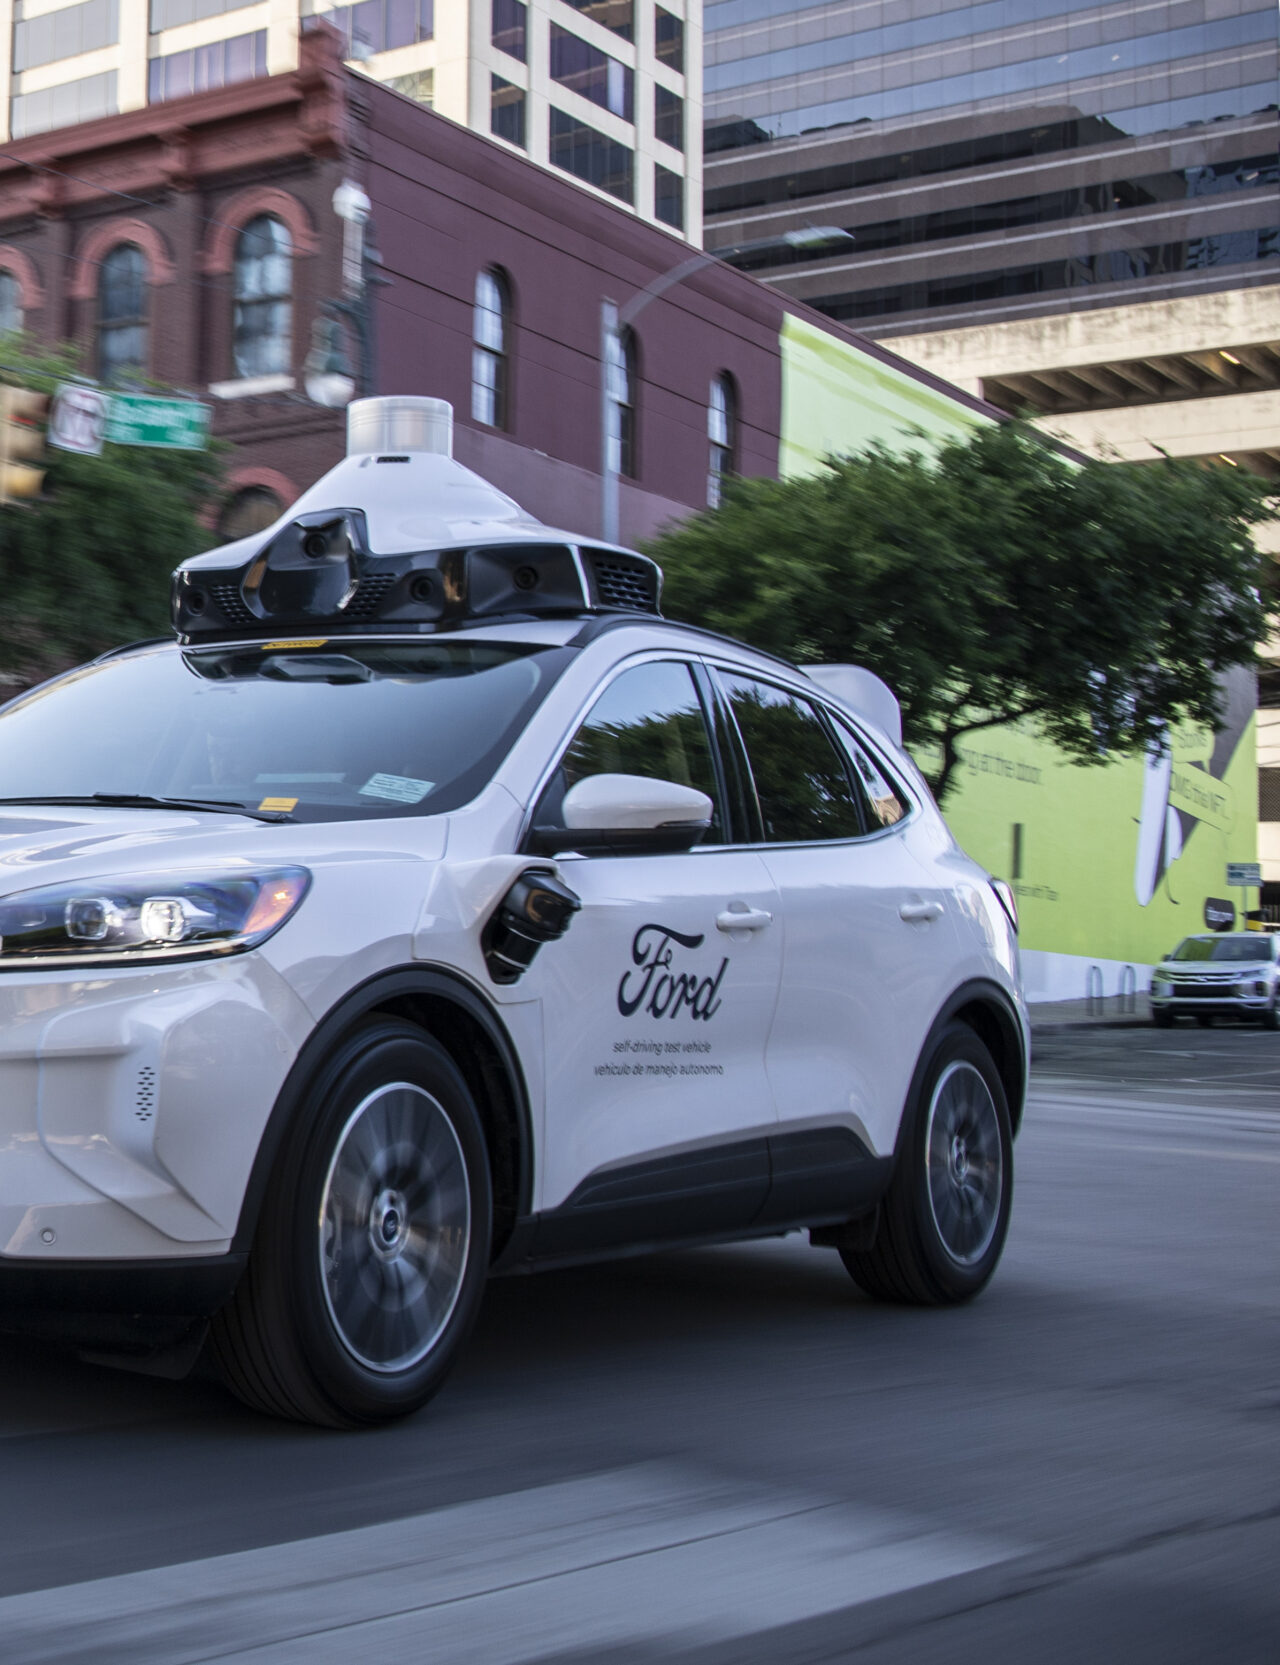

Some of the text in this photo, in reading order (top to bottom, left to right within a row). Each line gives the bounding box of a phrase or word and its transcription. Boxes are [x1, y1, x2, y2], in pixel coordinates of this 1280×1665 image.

[617, 923, 730, 1022] Ford
[612, 1039, 712, 1056] self-driving test vehicle
[631, 1063, 644, 1076] de
[645, 1061, 678, 1078] manejo
